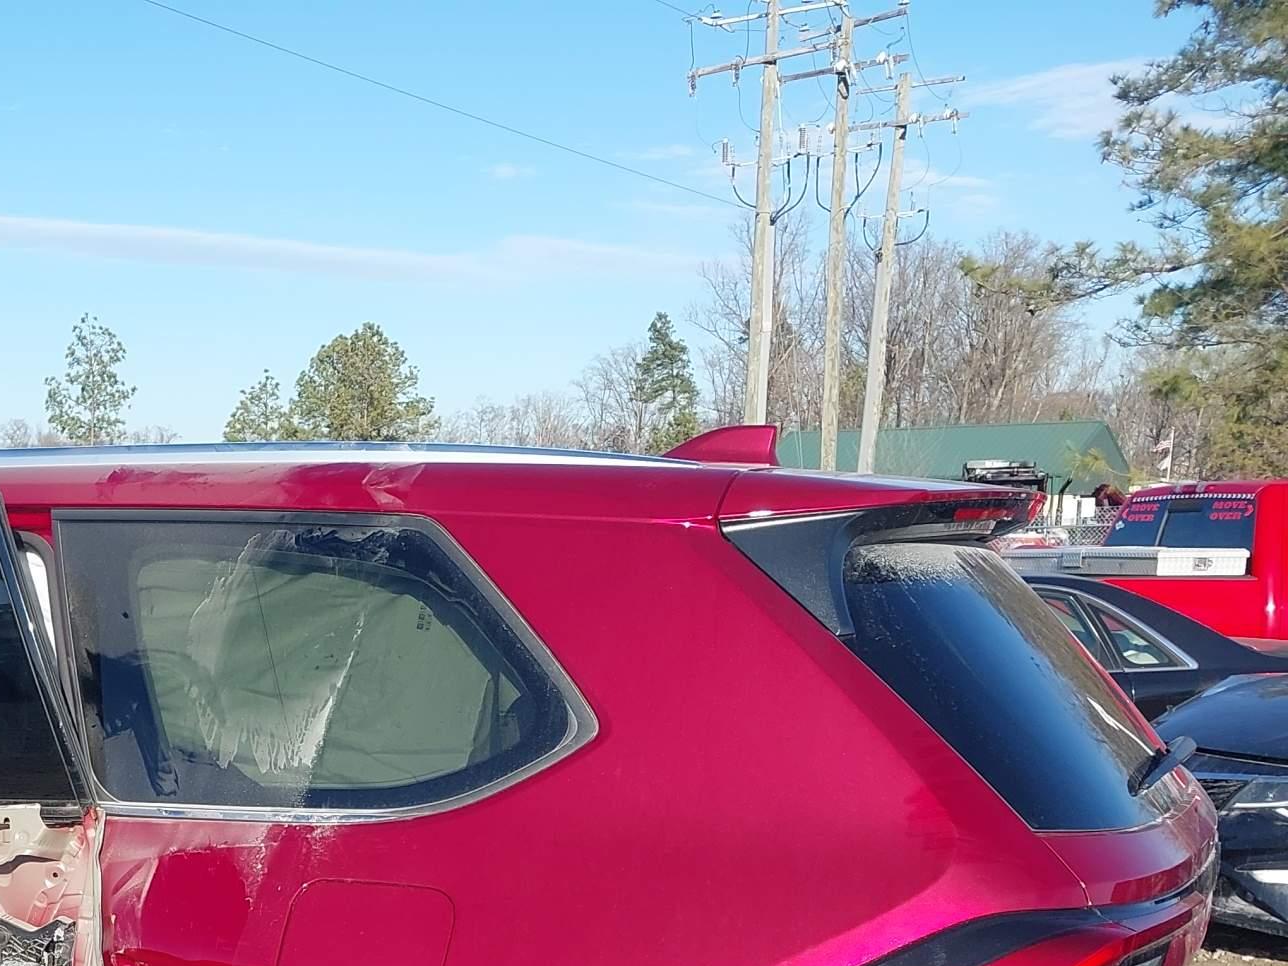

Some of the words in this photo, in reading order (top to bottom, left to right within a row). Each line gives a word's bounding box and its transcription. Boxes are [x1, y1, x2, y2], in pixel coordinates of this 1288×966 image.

[1131, 503, 1160, 511] MOVE
[1212, 501, 1248, 509] MOVE
[1127, 514, 1155, 522] OVER
[1209, 512, 1241, 520] OVER
